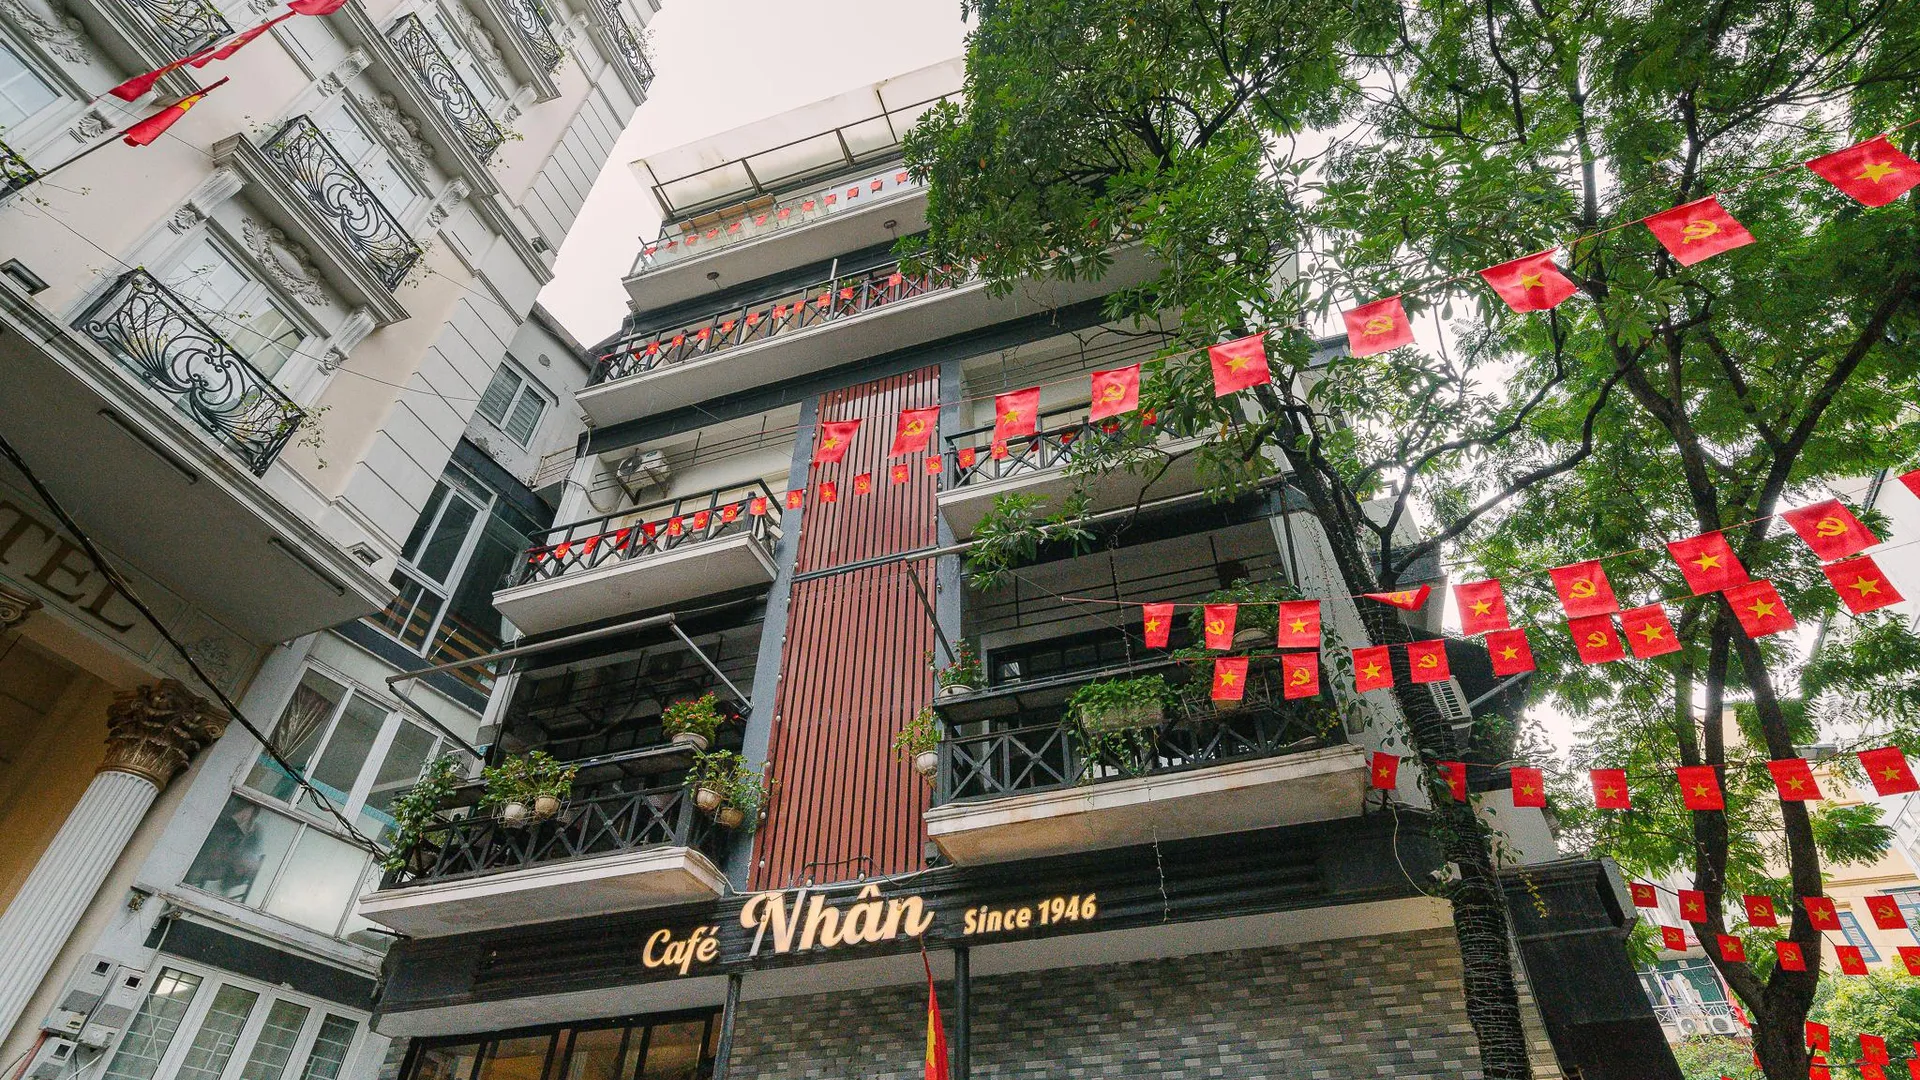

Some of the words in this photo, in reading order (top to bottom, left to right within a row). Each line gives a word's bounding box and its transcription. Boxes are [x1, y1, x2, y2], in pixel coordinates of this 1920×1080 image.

[643, 926, 720, 975] Café
[740, 884, 935, 957] Nhân
[963, 905, 1032, 935] Since
[1038, 893, 1097, 925] 1946
